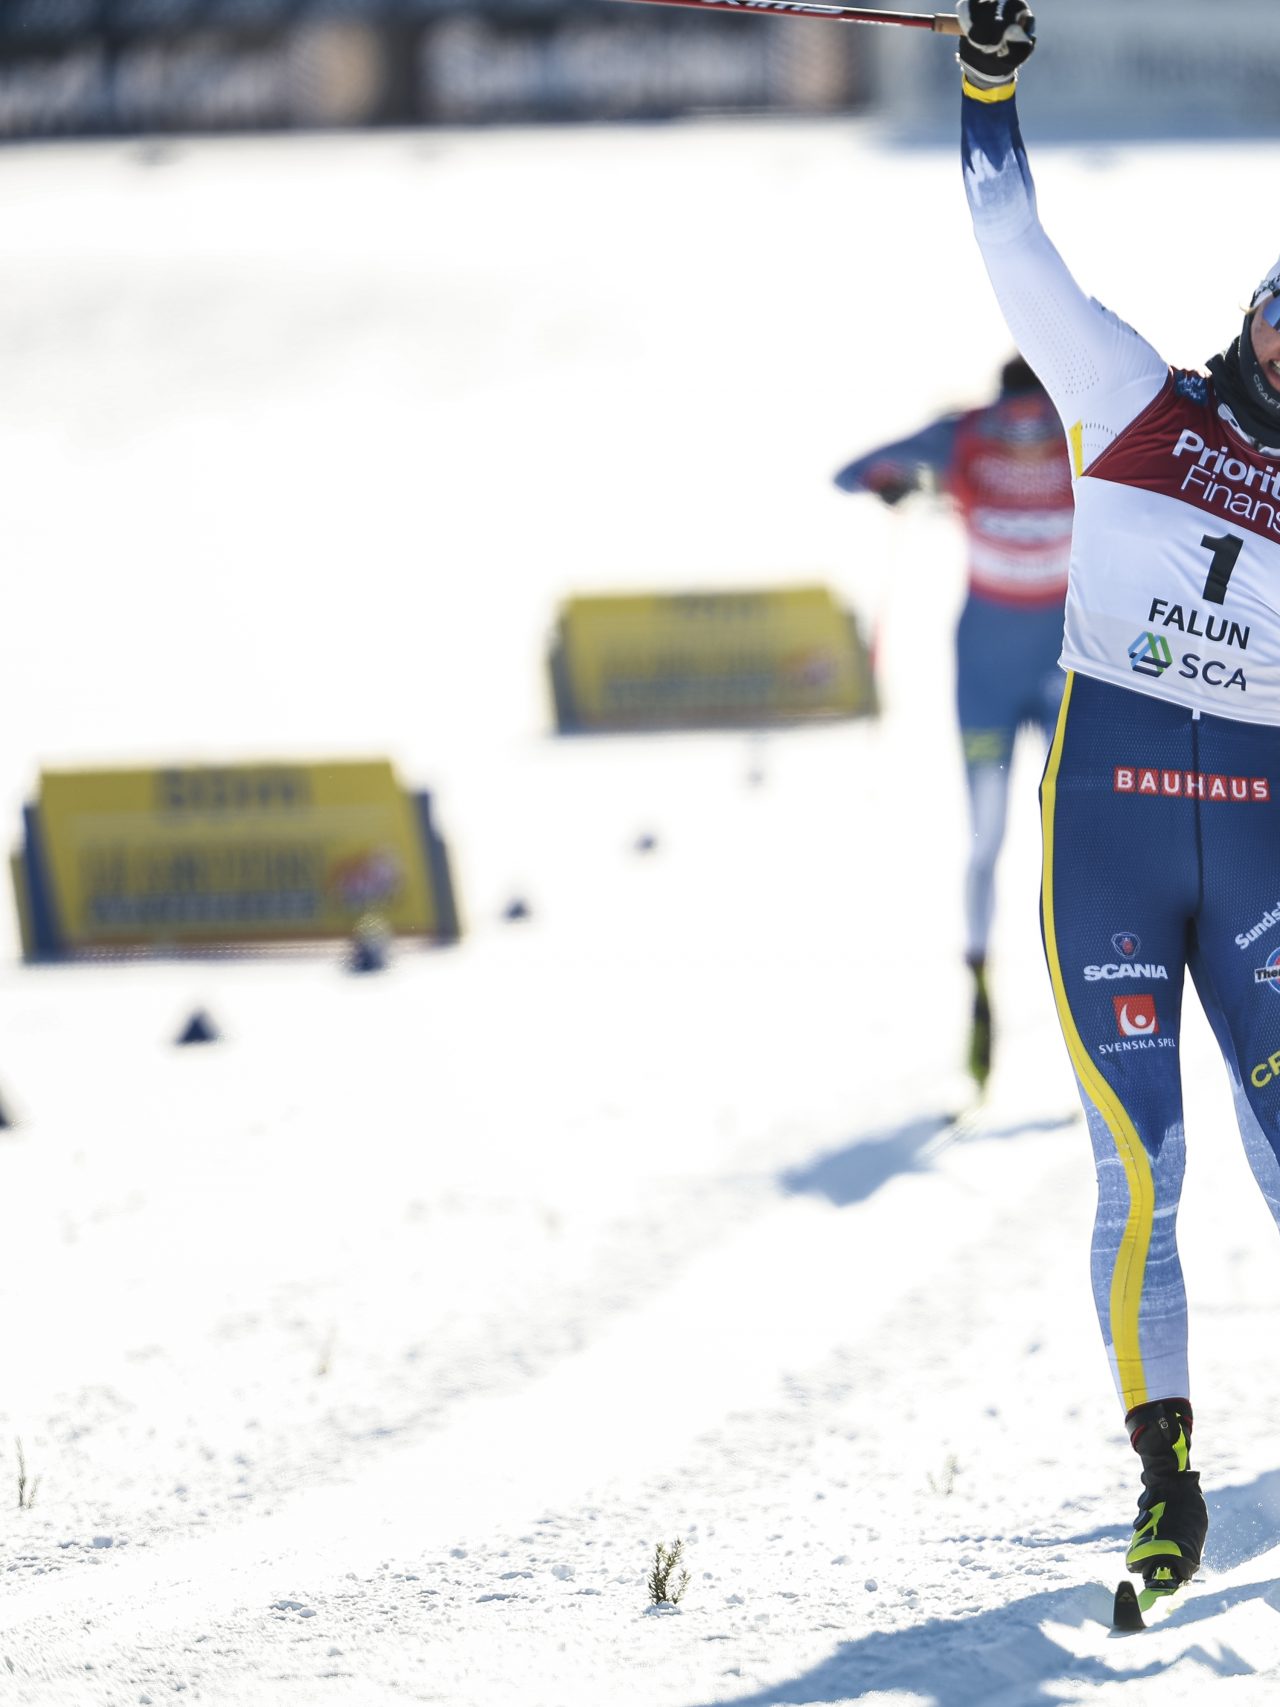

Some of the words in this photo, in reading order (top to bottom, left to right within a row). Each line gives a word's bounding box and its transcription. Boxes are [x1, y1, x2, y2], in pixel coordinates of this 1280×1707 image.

[1200, 533, 1244, 605] 1
[1148, 598, 1250, 650] FALUN
[1178, 653, 1247, 692] SCA
[1117, 769, 1269, 799] BAUHAUS
[1083, 963, 1168, 981] SCANIA
[1099, 1038, 1156, 1055] SVENSKA
[1158, 1037, 1176, 1049] SPEL
